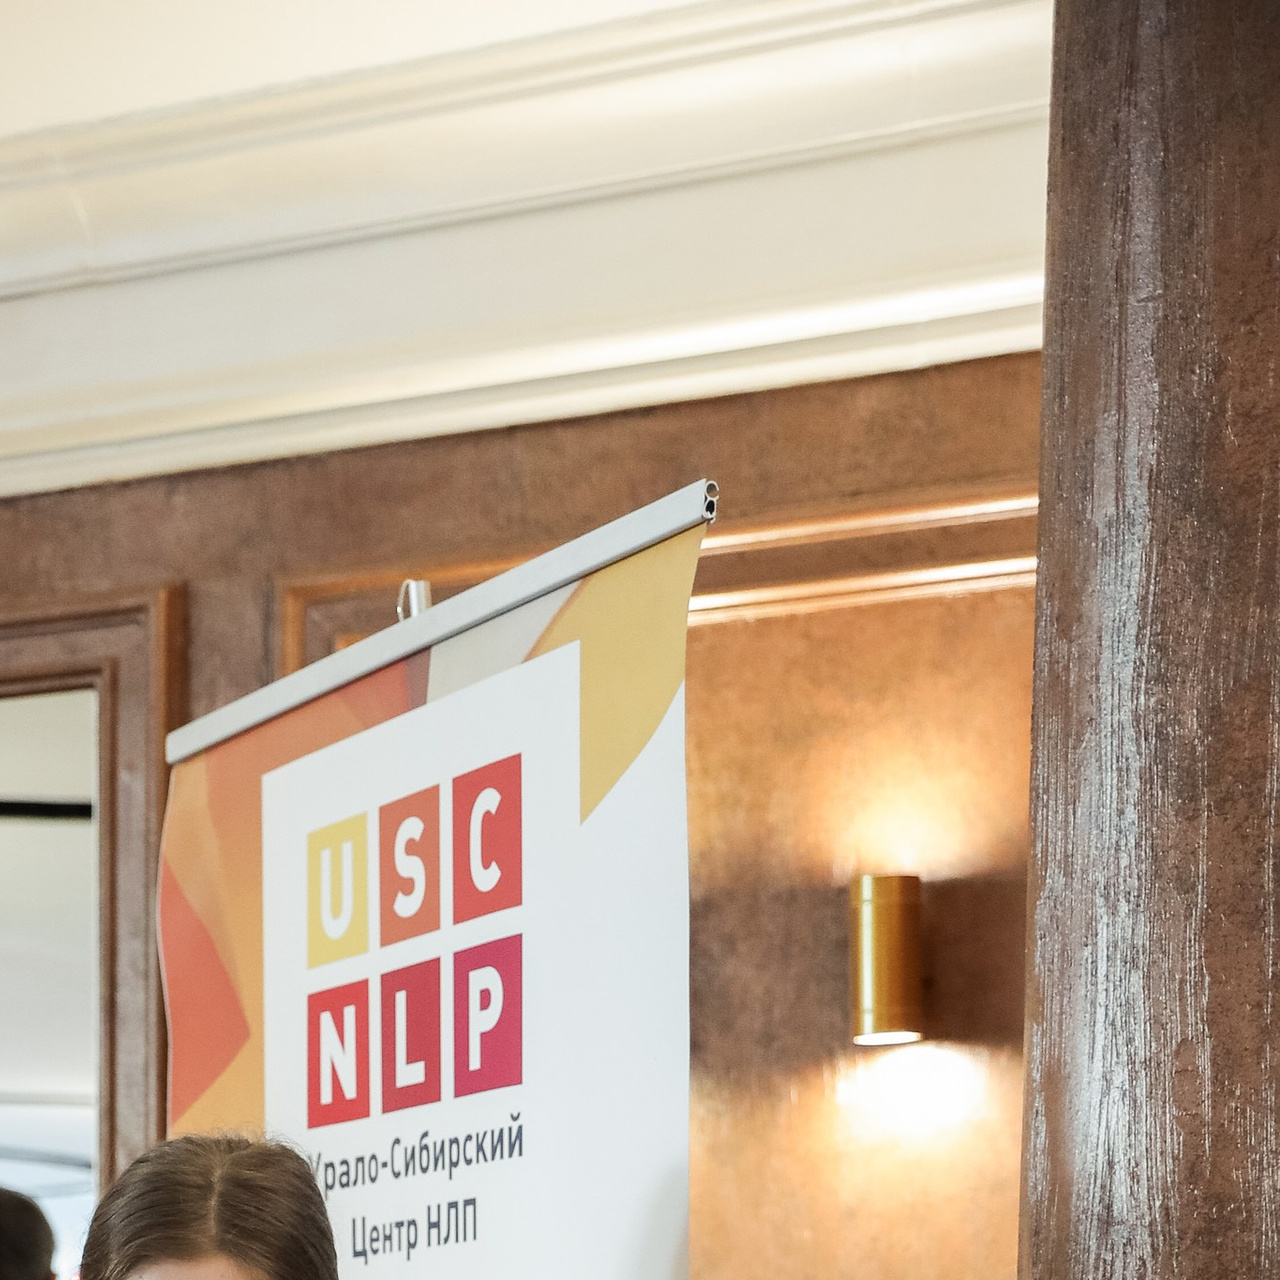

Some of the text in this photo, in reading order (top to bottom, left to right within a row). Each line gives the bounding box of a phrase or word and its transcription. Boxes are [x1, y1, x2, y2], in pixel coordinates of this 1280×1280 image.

[320, 786, 502, 941] USC
[319, 964, 503, 1106] NLP
[352, 1198, 477, 1265] Центр НЛП
